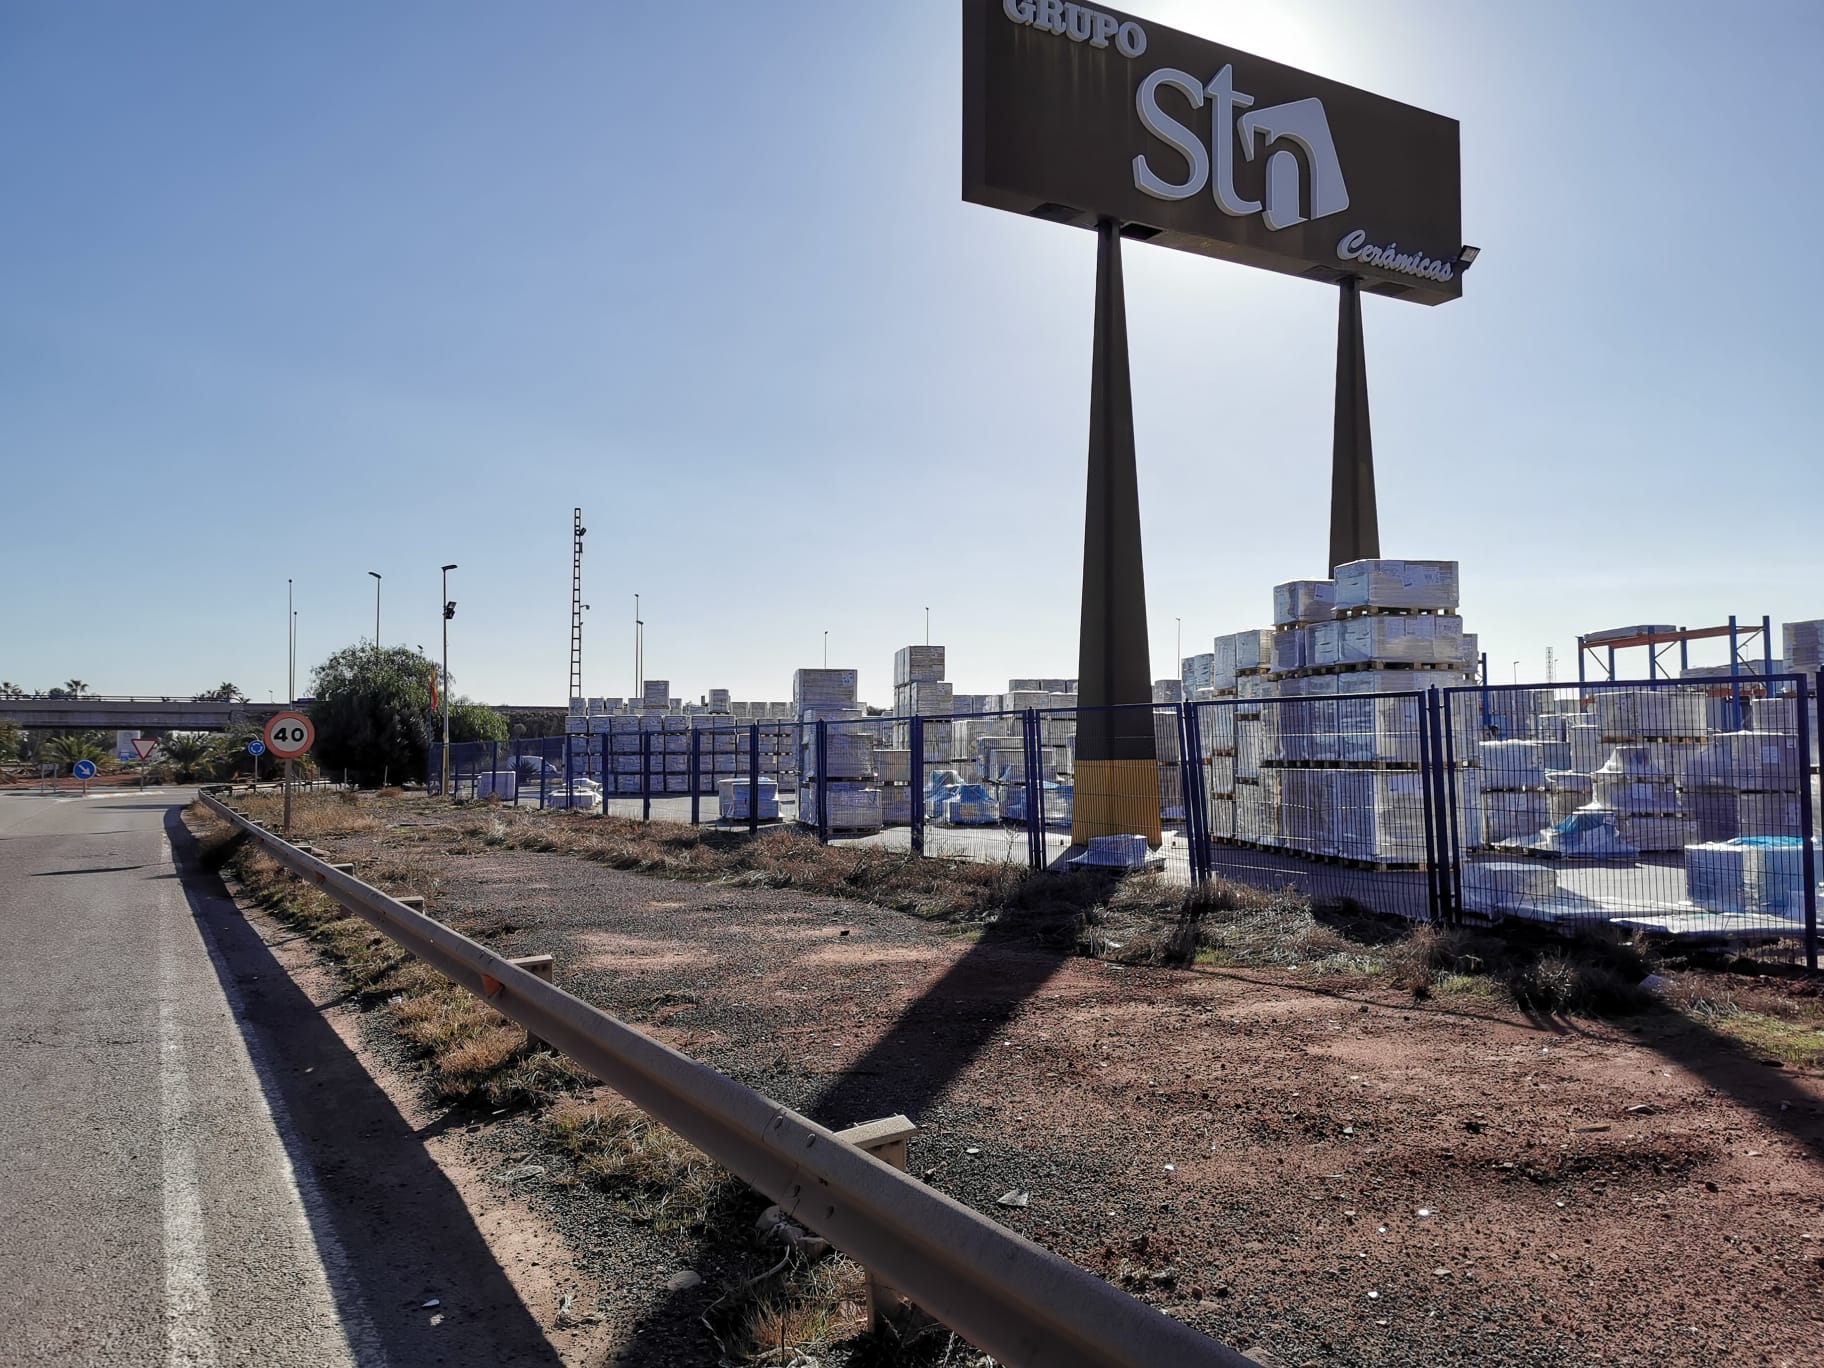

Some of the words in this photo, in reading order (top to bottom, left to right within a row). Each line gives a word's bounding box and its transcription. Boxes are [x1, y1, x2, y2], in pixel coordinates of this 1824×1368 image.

[1002, 0, 1147, 59] GRUPO
[1336, 229, 1454, 282] Cerámicas
[273, 727, 305, 742] 40
